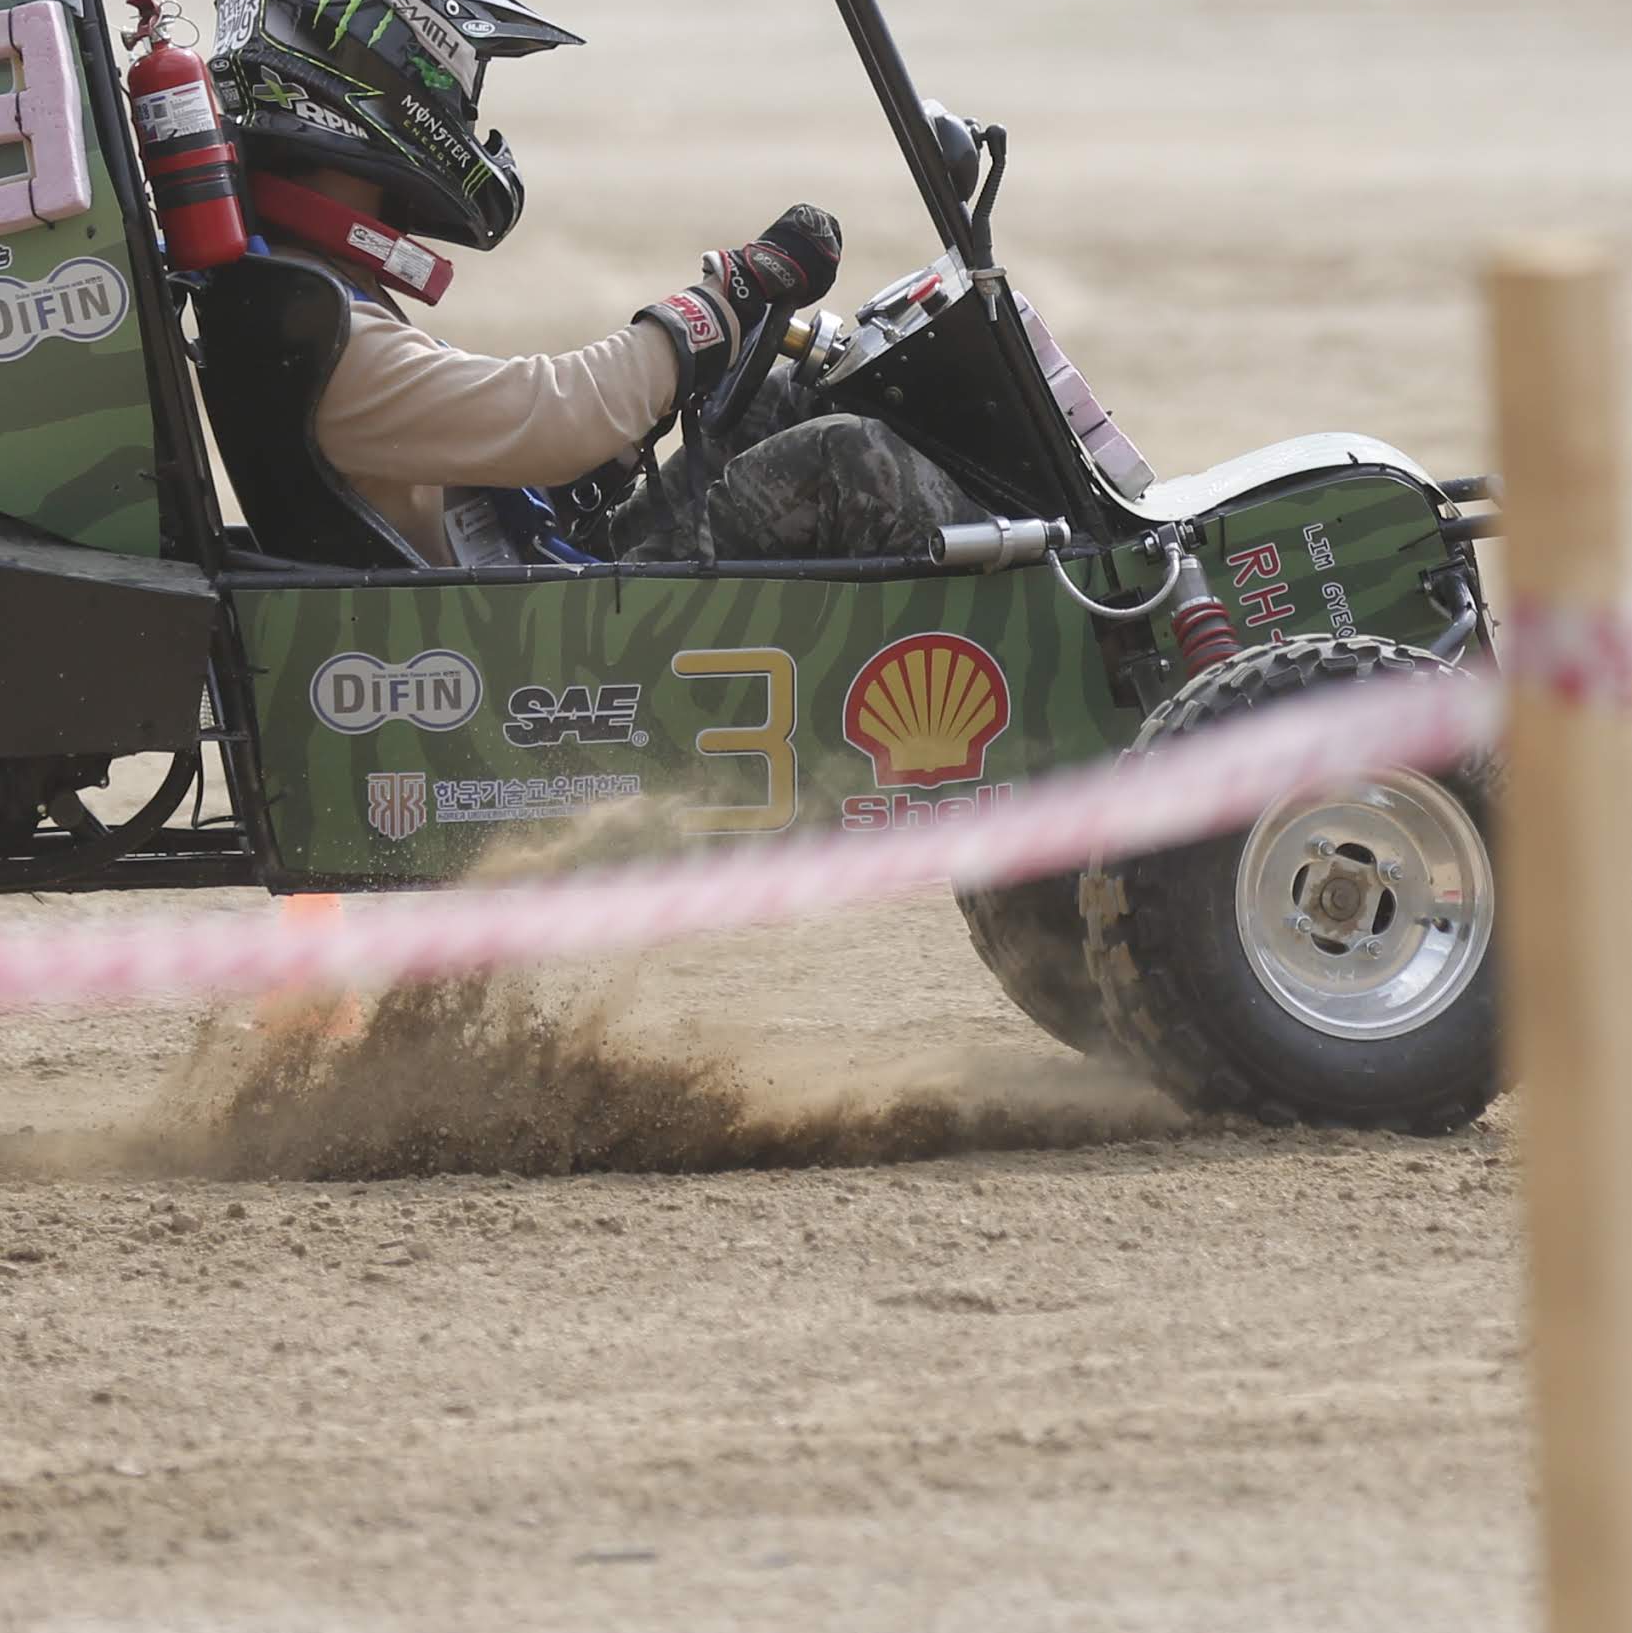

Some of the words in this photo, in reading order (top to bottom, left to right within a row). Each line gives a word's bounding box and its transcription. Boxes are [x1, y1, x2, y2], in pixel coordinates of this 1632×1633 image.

[296, 101, 370, 140] RPHA
[401, 94, 472, 169] MONSTER
[403, 118, 453, 168] ENERGY
[727, 257, 749, 299] arco
[754, 252, 795, 289] sparco
[1303, 523, 1335, 572] LIM
[333, 673, 463, 714] DIFIN
[671, 647, 798, 835] 3
[434, 775, 640, 810] 한국기술교육대학교
